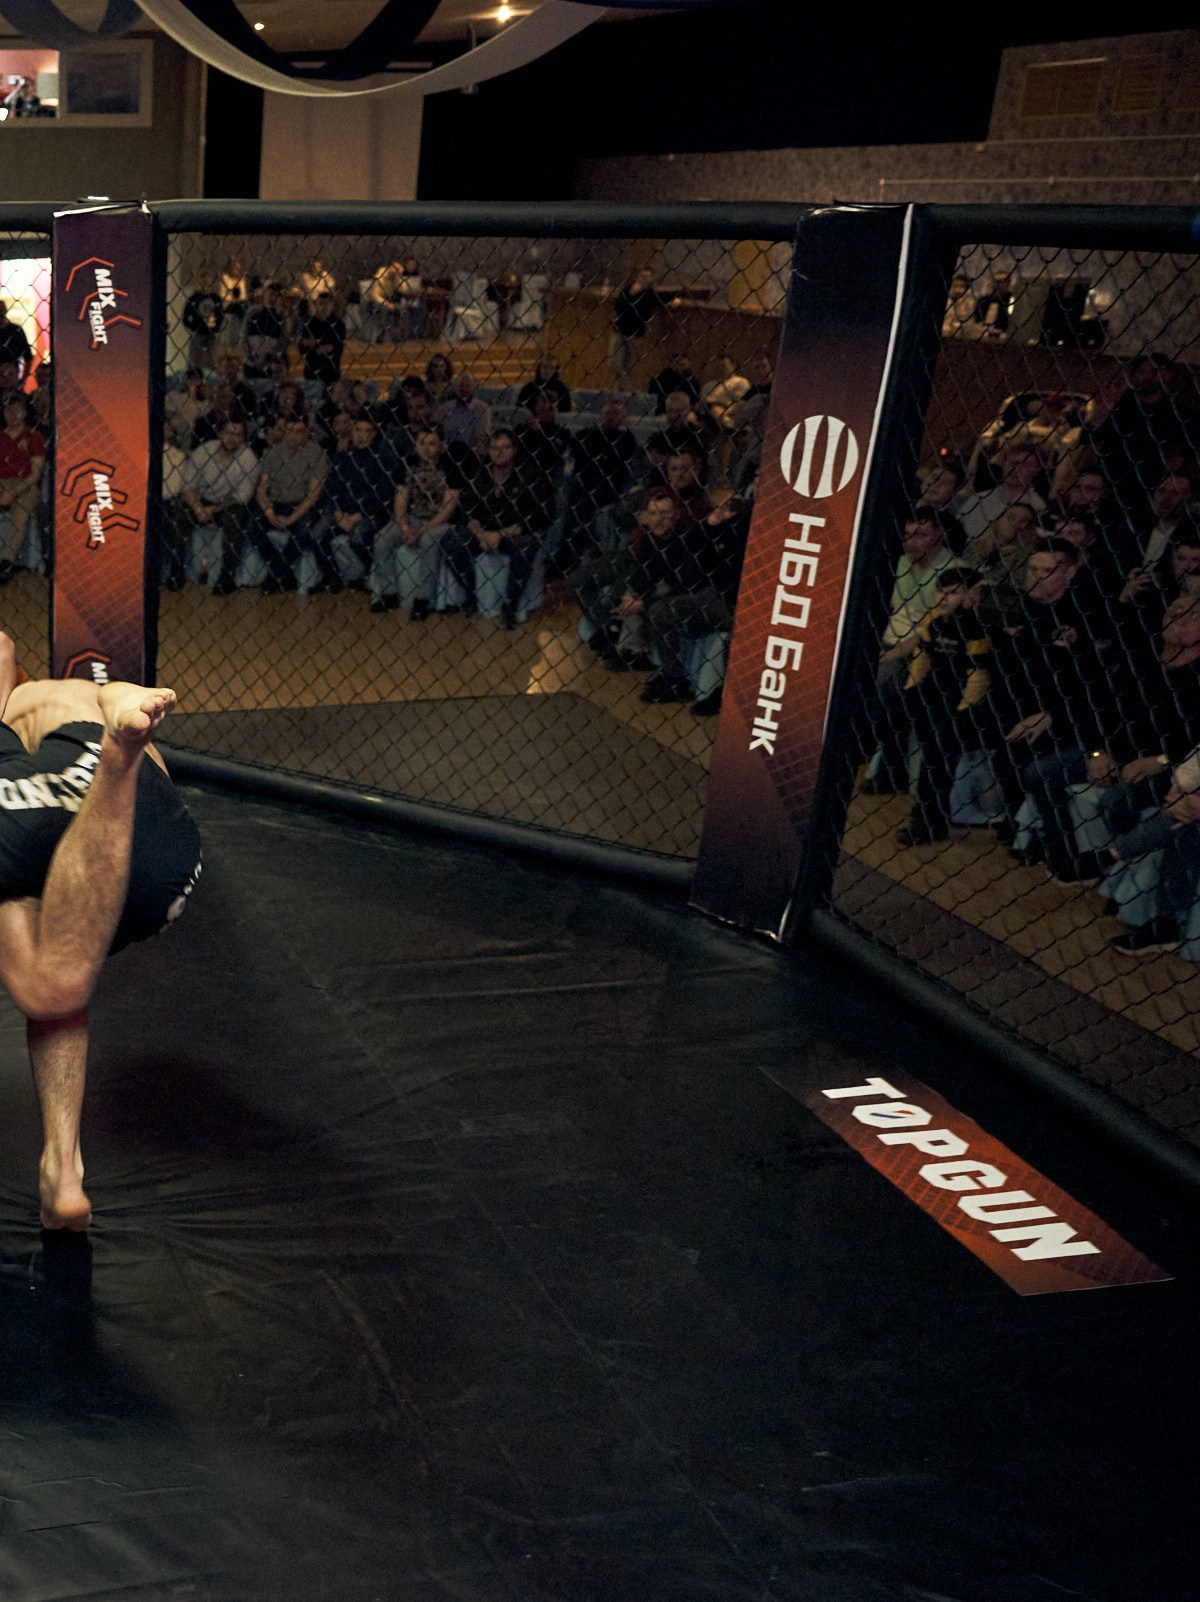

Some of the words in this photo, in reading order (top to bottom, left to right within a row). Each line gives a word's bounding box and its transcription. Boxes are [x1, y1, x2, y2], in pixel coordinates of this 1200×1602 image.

[94, 268, 116, 308] MIX
[89, 301, 108, 344] FIGHT
[93, 473, 114, 511] MIX
[87, 504, 106, 544] FIGHT
[770, 512, 827, 629] НБД
[91, 662, 109, 684] MI
[749, 635, 804, 756] Банк
[821, 1077, 1102, 1262] TOPGUN
